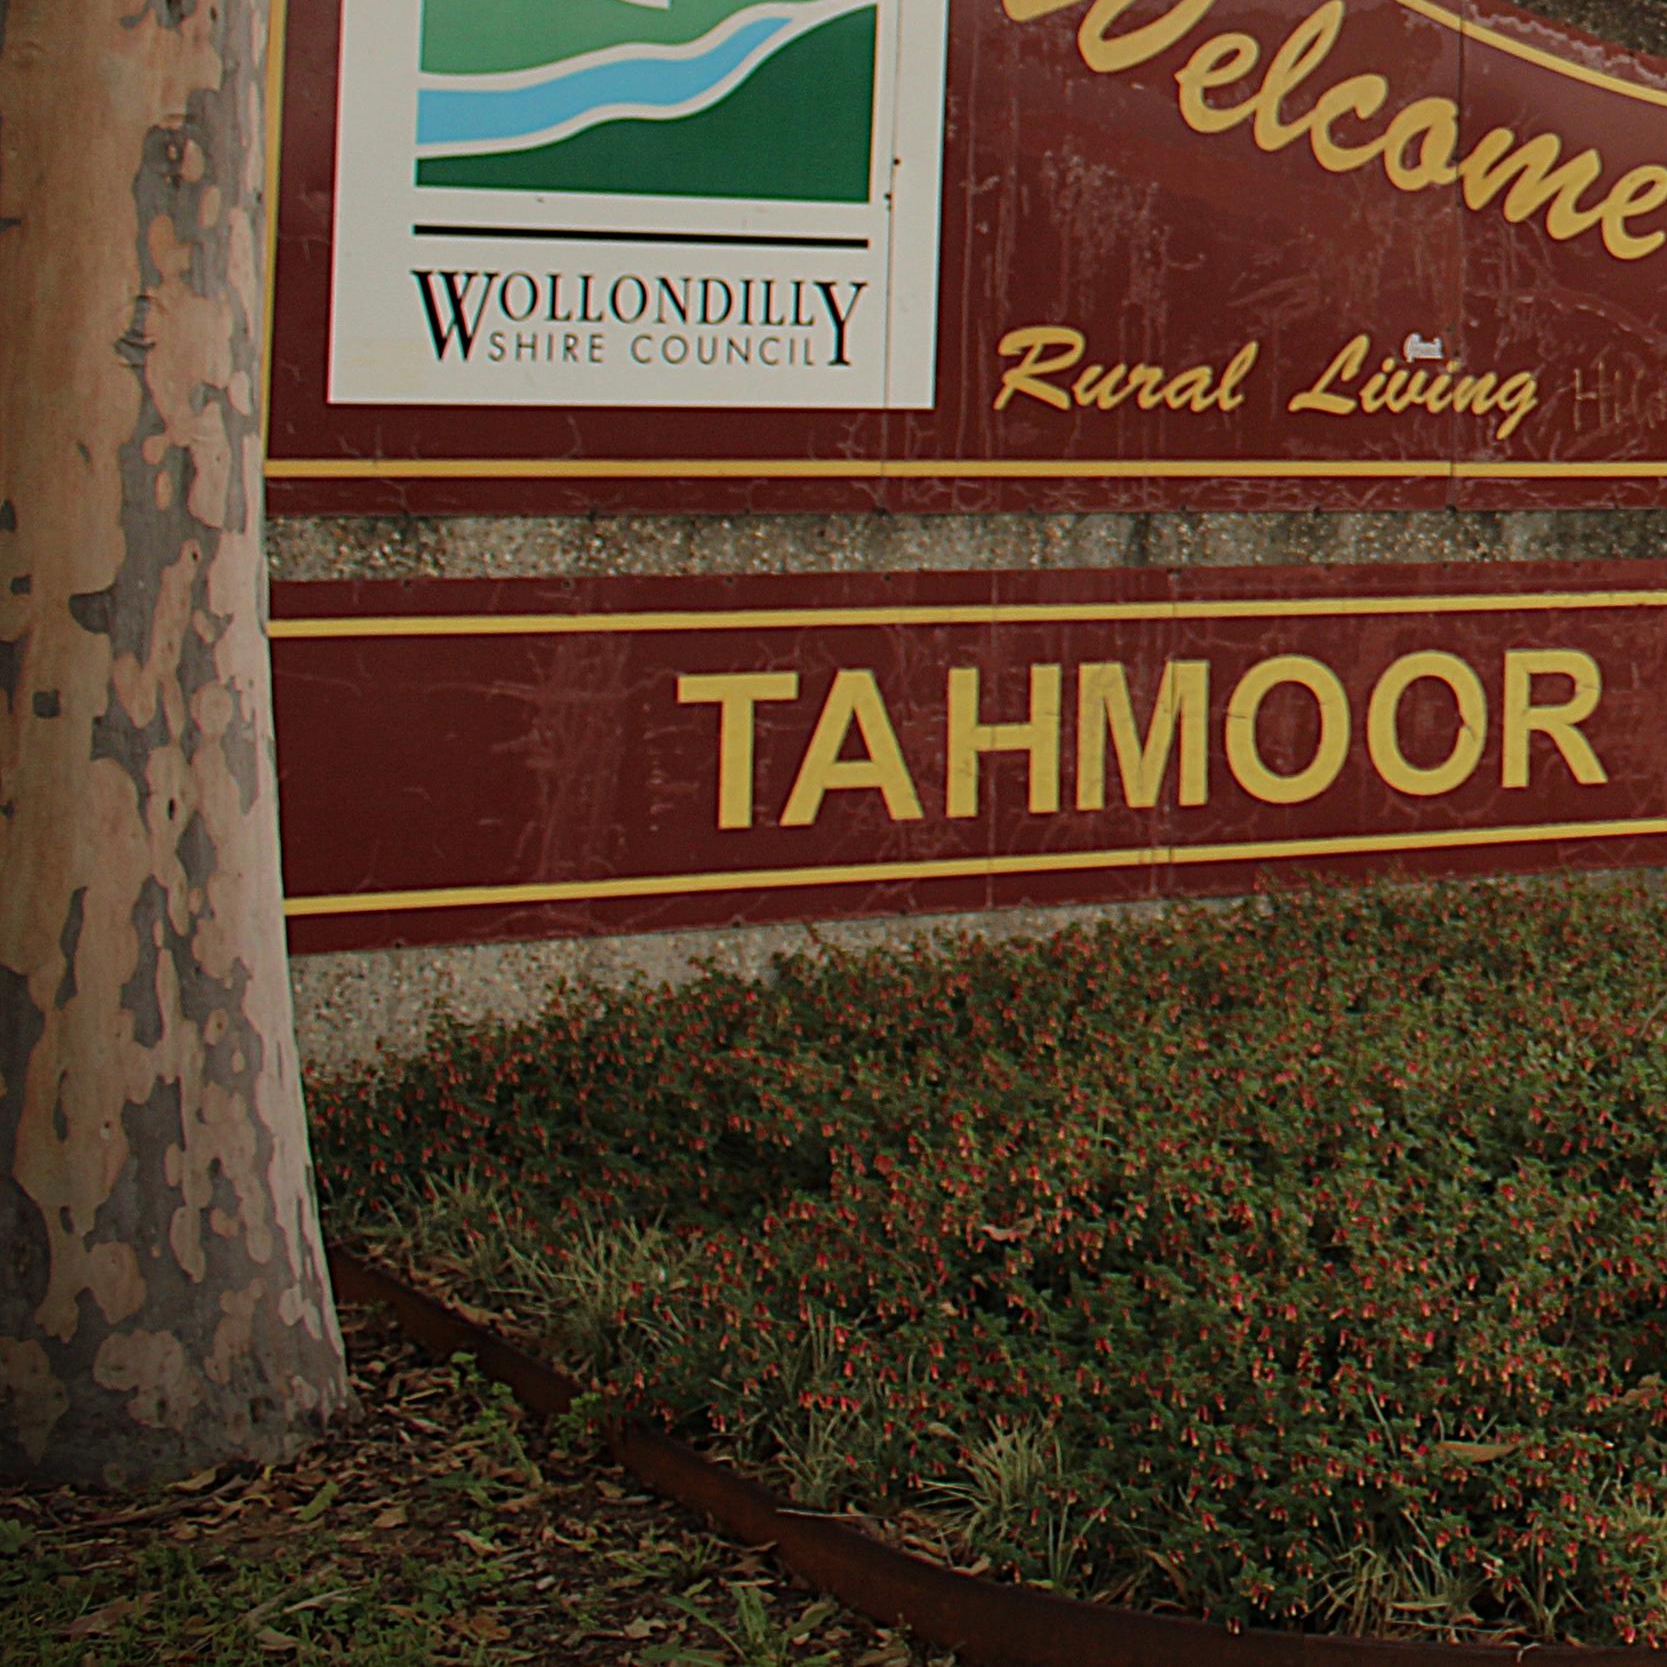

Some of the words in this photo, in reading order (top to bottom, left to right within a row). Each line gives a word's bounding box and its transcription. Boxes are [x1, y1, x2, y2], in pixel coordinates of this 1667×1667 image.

[411, 269, 870, 368] WOLLONDILLY
[487, 332, 606, 364] SHIRE
[631, 334, 815, 366] COUNCIL
[993, 325, 1259, 413] Rural
[1288, 334, 1539, 440] Living
[676, 647, 1610, 829] TAHMOOR
